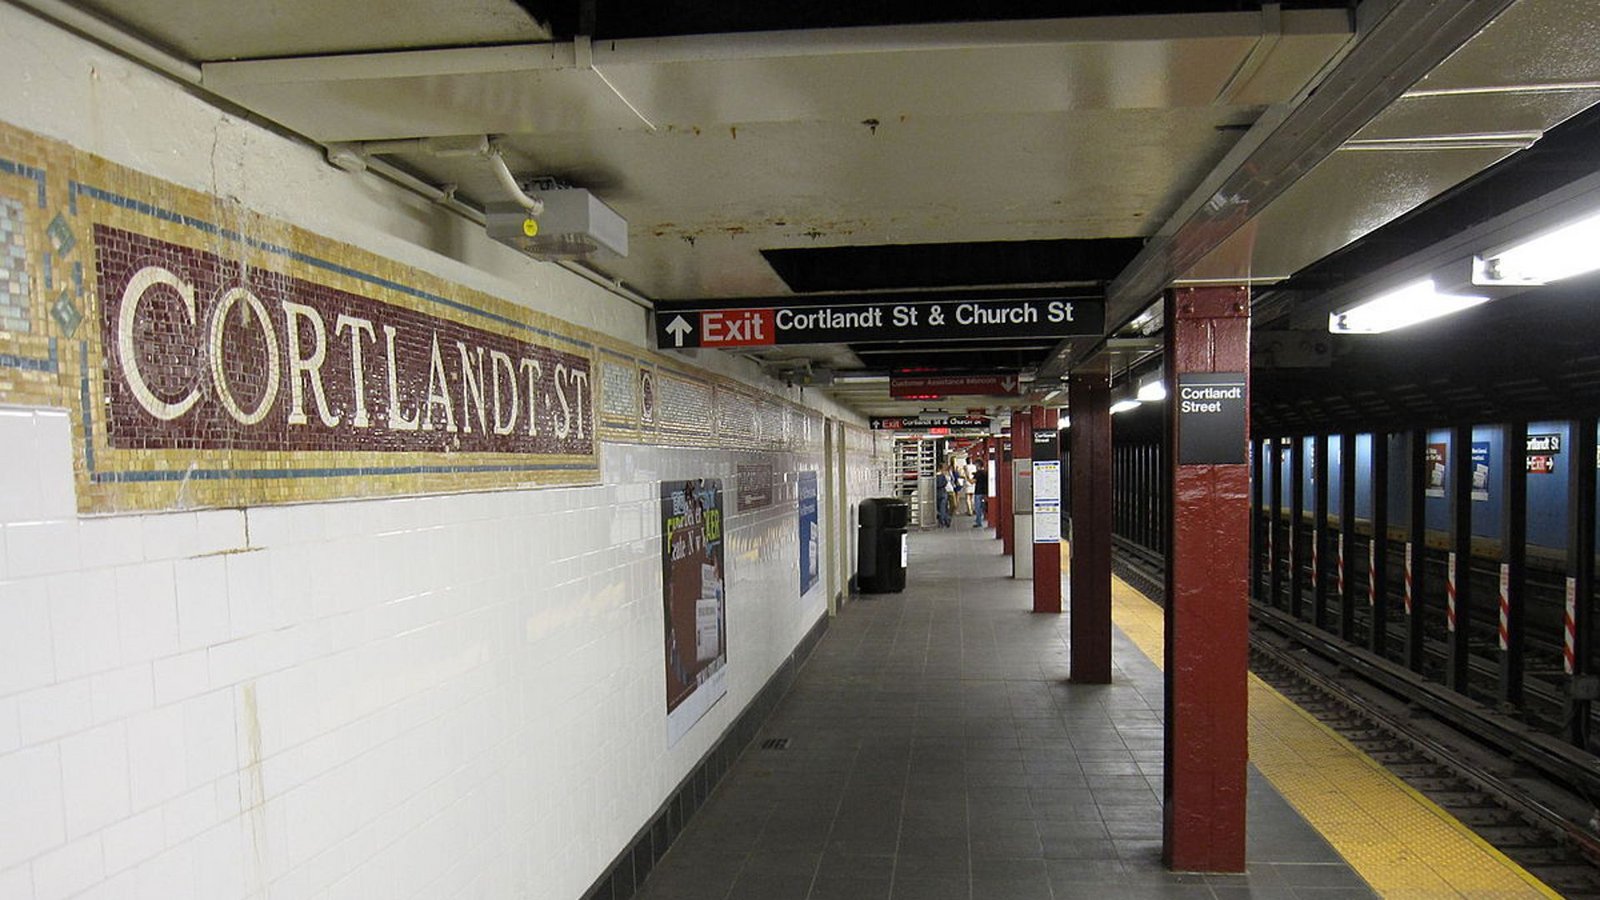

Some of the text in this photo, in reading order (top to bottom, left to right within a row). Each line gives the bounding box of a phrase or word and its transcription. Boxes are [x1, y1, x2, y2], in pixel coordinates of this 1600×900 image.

[702, 301, 1074, 342] Exit Cortlandt St & Church St
[117, 265, 588, 440] CORTLANDT ST
[891, 378, 925, 387] Customer
[927, 377, 964, 386] Assistance
[1181, 387, 1241, 400] Cortlandt
[1181, 400, 1222, 413] Street
[882, 419, 900, 430] Exit
